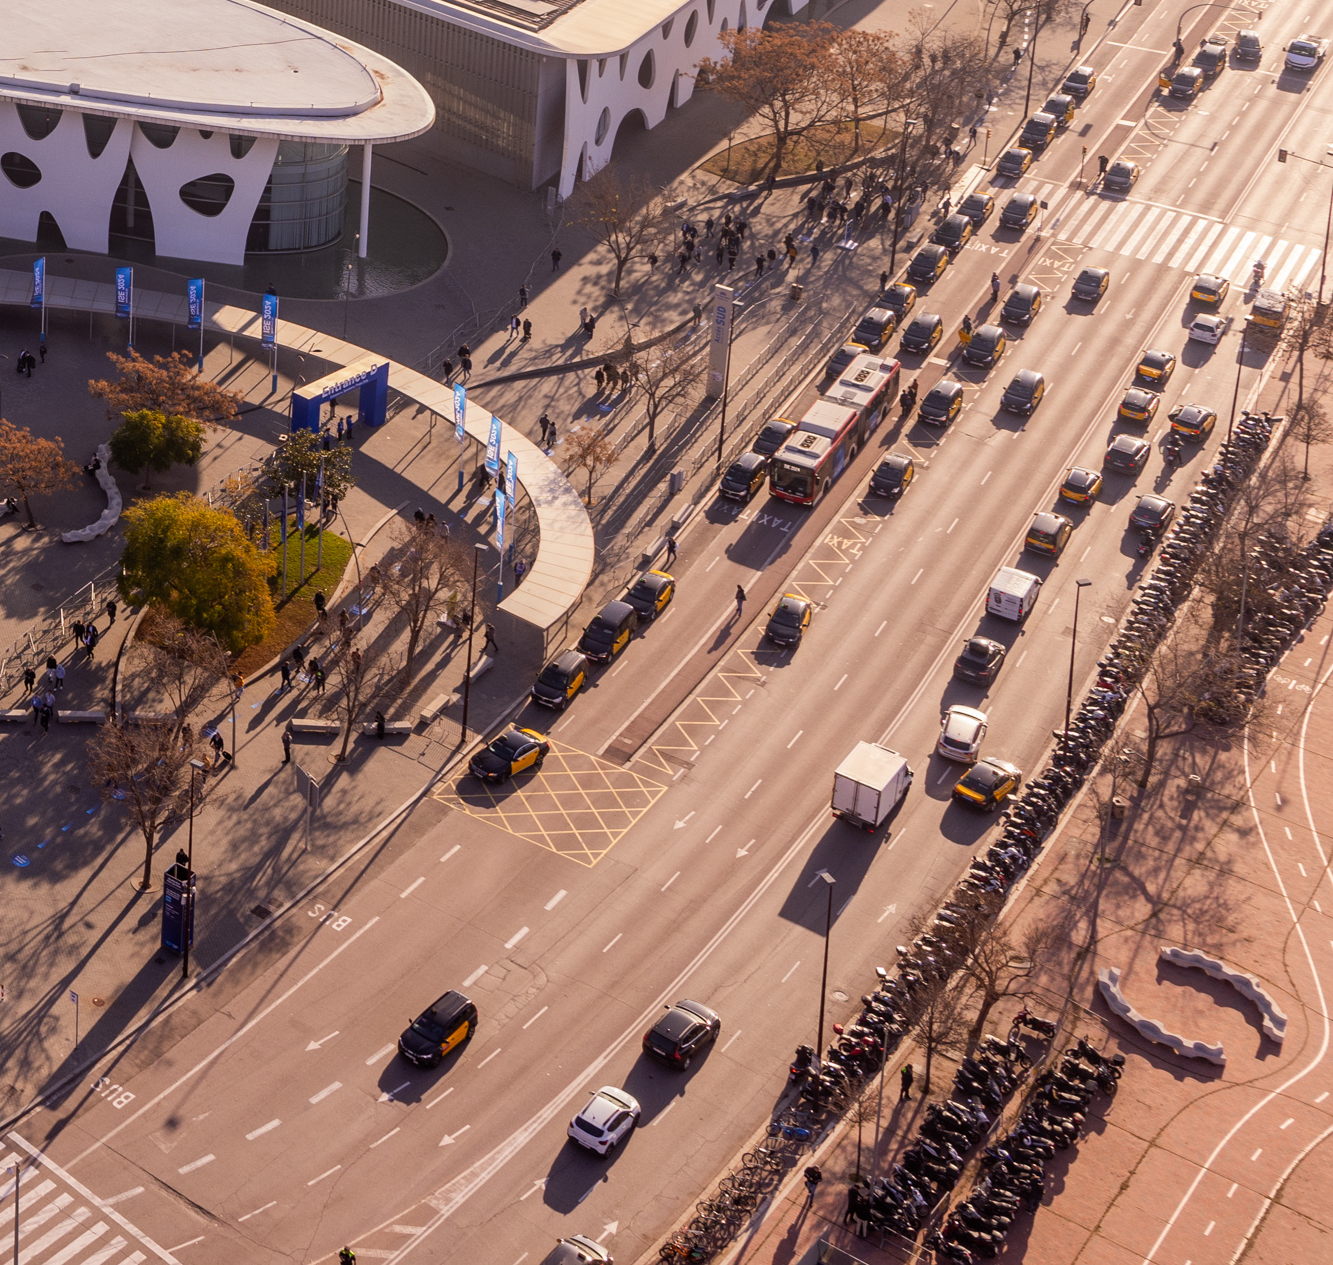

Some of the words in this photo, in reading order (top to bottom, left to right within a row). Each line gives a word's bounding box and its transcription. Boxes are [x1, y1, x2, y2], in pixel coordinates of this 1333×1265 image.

[715, 306, 726, 326] SUD
[321, 371, 367, 397] Entrance
[370, 363, 378, 375] D
[90, 1077, 136, 1109] BUS
